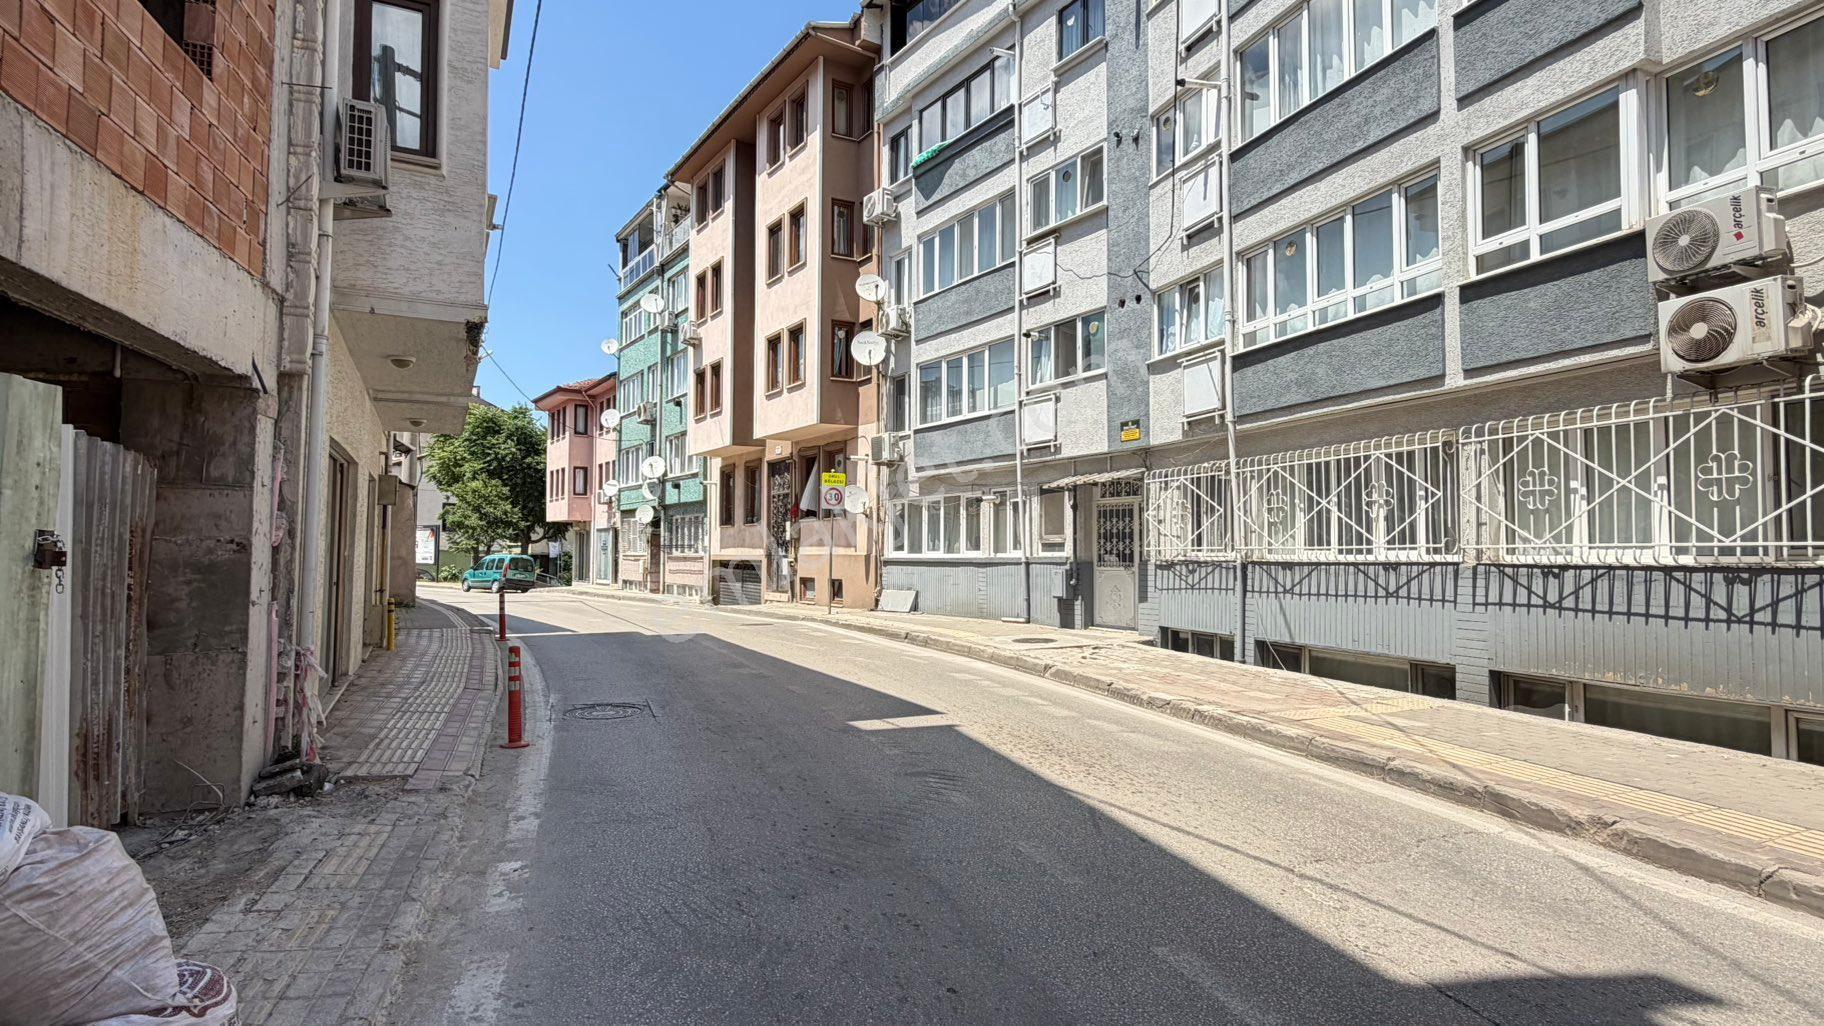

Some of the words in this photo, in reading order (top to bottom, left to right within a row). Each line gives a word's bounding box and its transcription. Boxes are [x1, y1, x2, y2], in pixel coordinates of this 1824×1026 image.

[1730, 194, 1745, 229] arçelik
[1751, 288, 1767, 328] arçelik
[828, 493, 839, 501] 30
